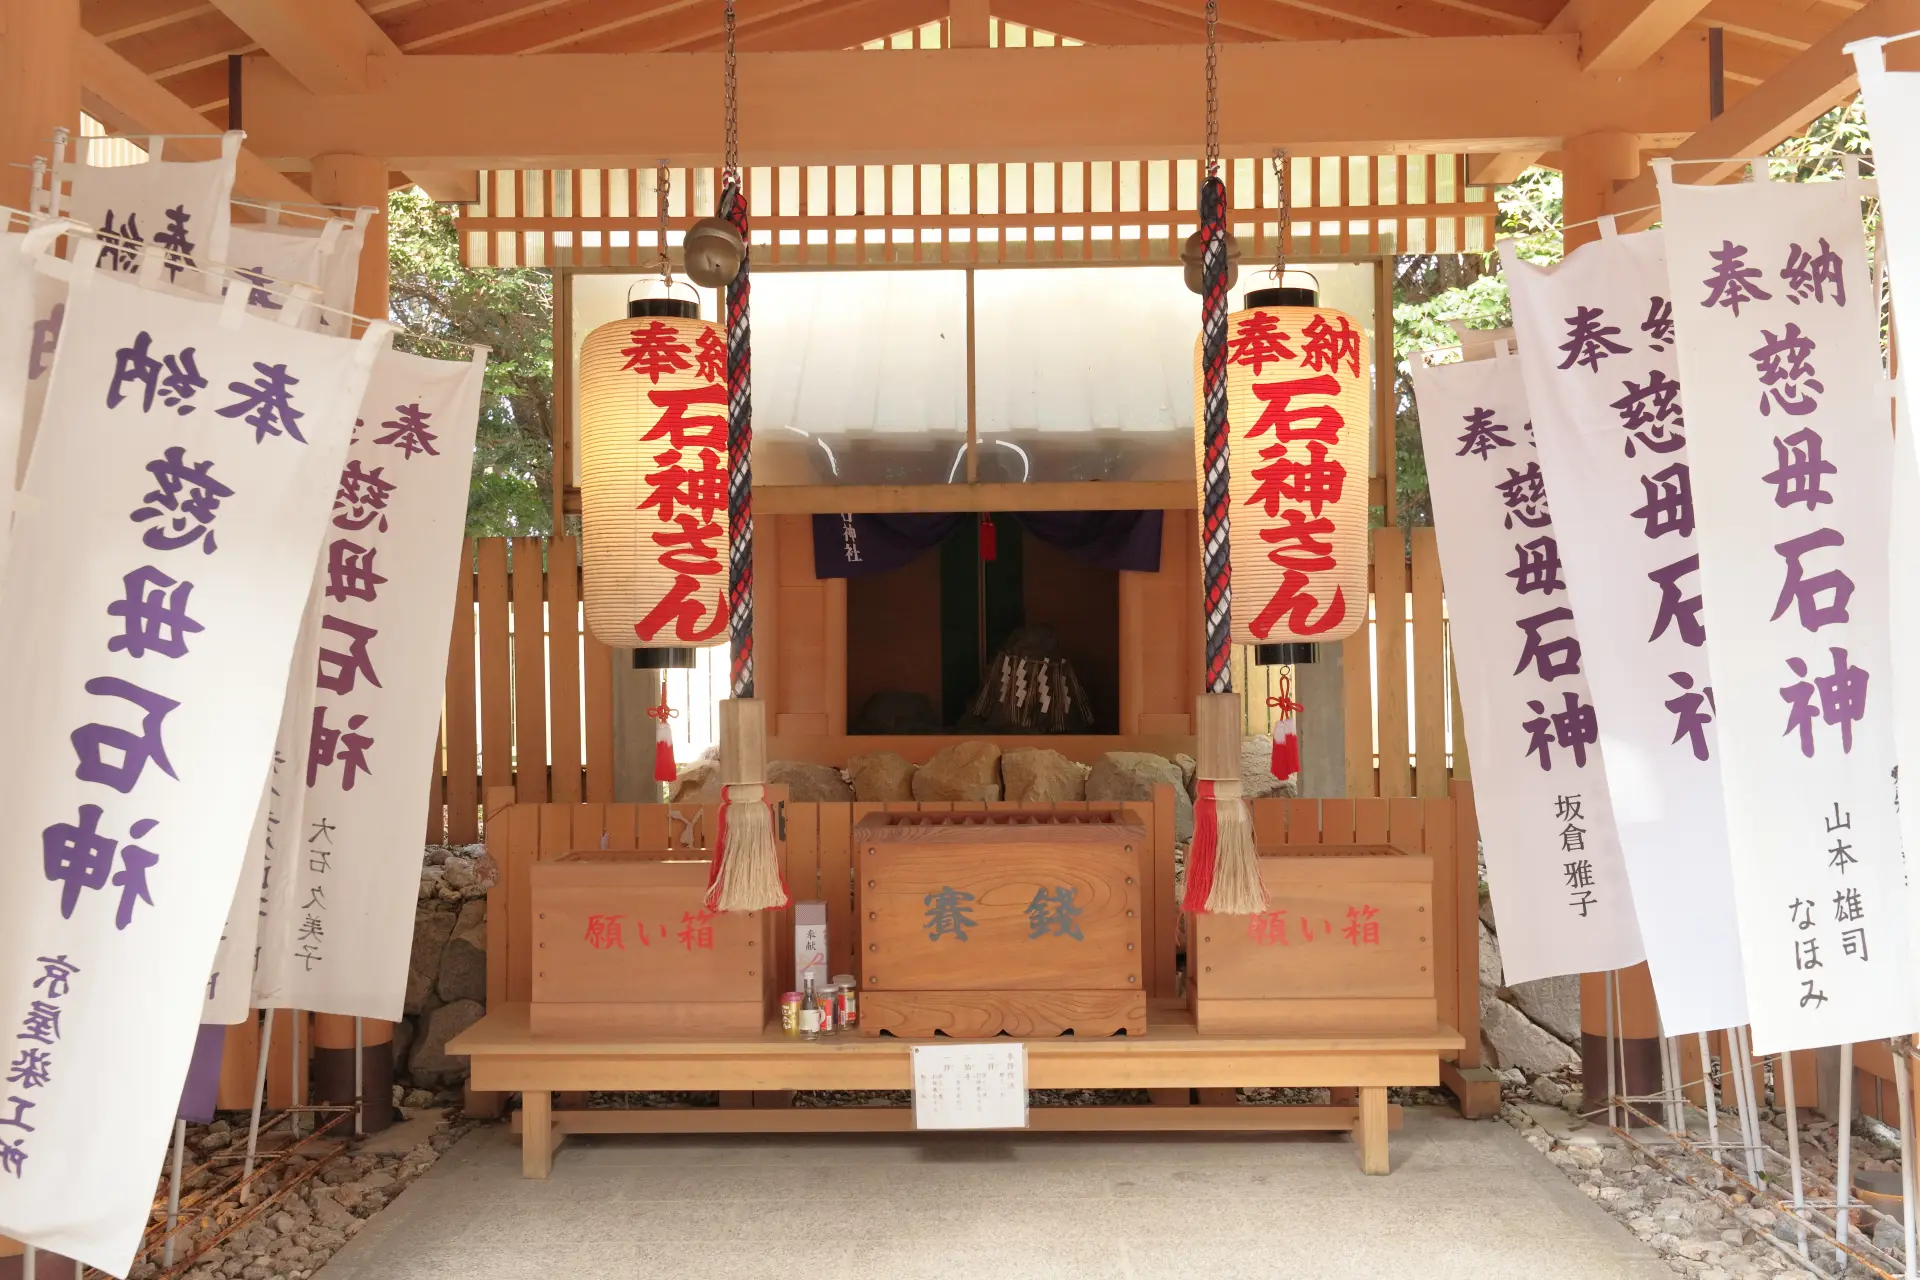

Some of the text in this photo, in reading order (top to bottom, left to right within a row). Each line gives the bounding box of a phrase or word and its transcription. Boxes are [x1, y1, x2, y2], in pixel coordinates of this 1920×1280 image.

[1700, 237, 1847, 317] 奉納
[1228, 311, 1361, 379] 奉納
[1455, 407, 1538, 461] 奉
[634, 382, 730, 641] 石神さん
[1244, 375, 1346, 640] 石神さん
[1749, 322, 1869, 759] 慈母石神
[1554, 794, 1597, 917] 坂倉 雅子
[1824, 802, 1869, 962] 山本 雄司
[584, 910, 718, 951] 願い箱
[805, 929, 816, 951] 奉献
[1248, 904, 1380, 946] 願い箱
[1789, 898, 1829, 1009] なほみ
